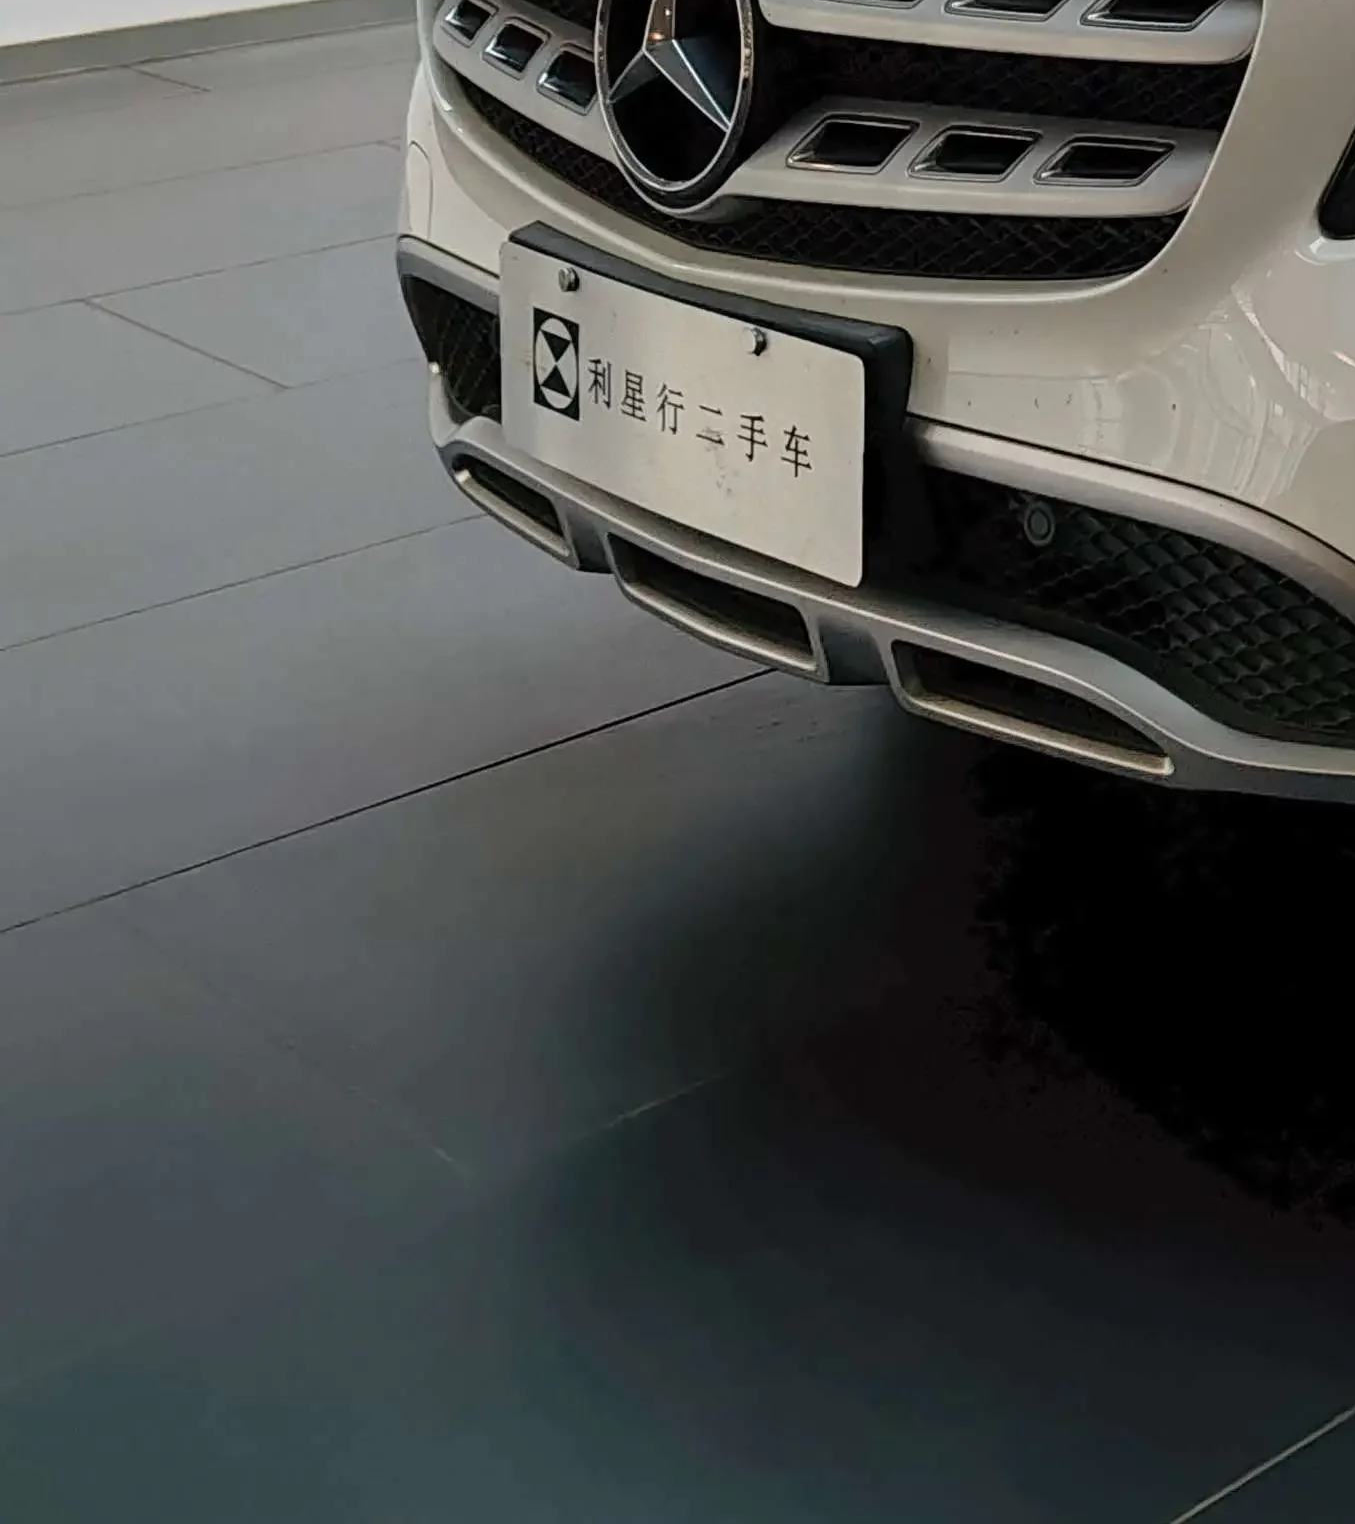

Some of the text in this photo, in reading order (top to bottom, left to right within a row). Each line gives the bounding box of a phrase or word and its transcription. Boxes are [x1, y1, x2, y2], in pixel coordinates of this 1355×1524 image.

[586, 357, 812, 478] 利星行二手车
